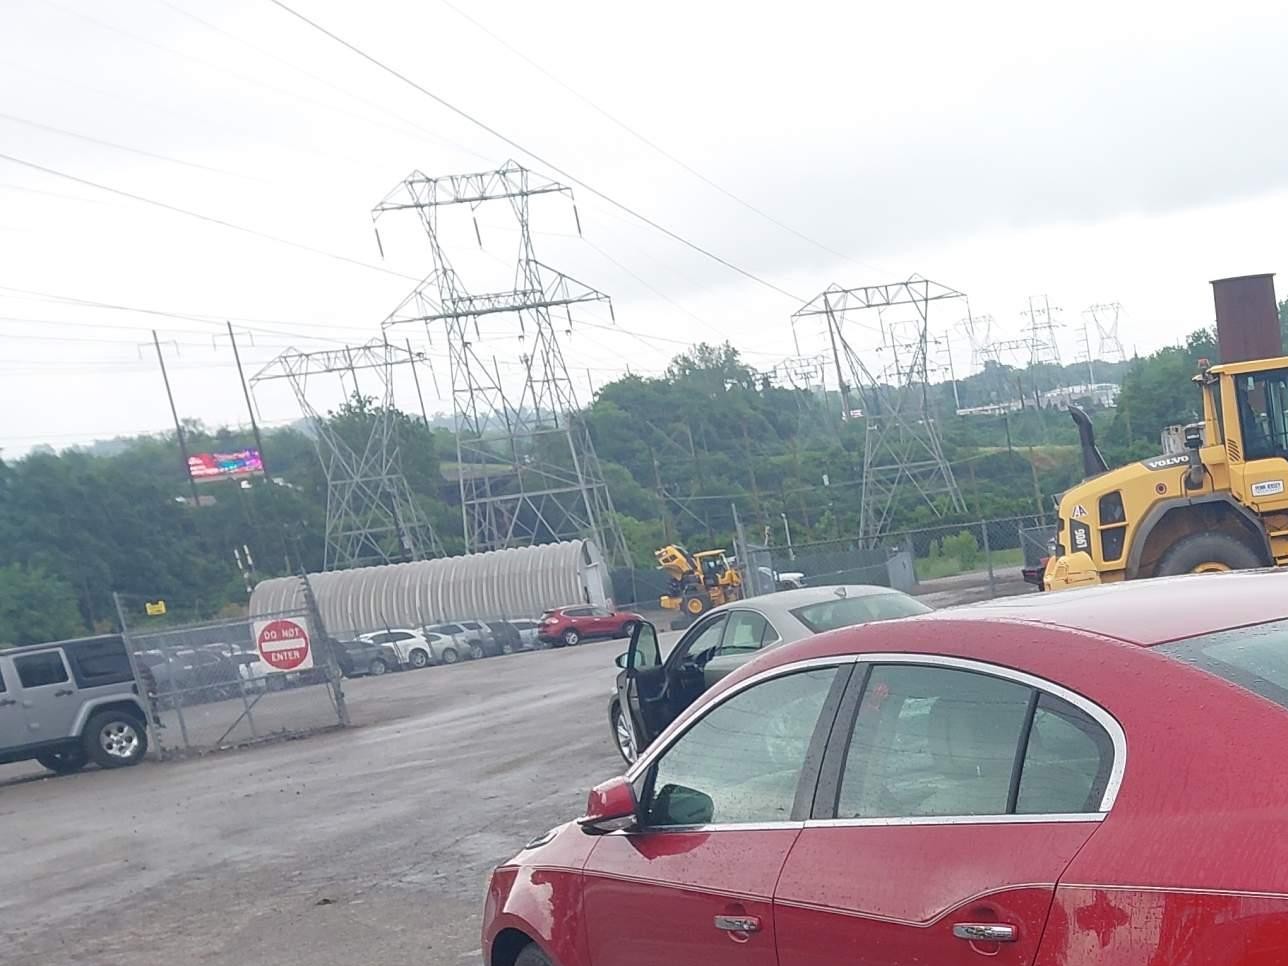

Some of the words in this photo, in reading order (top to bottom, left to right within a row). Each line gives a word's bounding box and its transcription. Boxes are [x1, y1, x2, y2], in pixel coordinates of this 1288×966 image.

[1149, 455, 1189, 467] VOLVO
[263, 630, 277, 640] DO
[281, 627, 299, 638] NOT
[271, 650, 300, 662] ENTER
